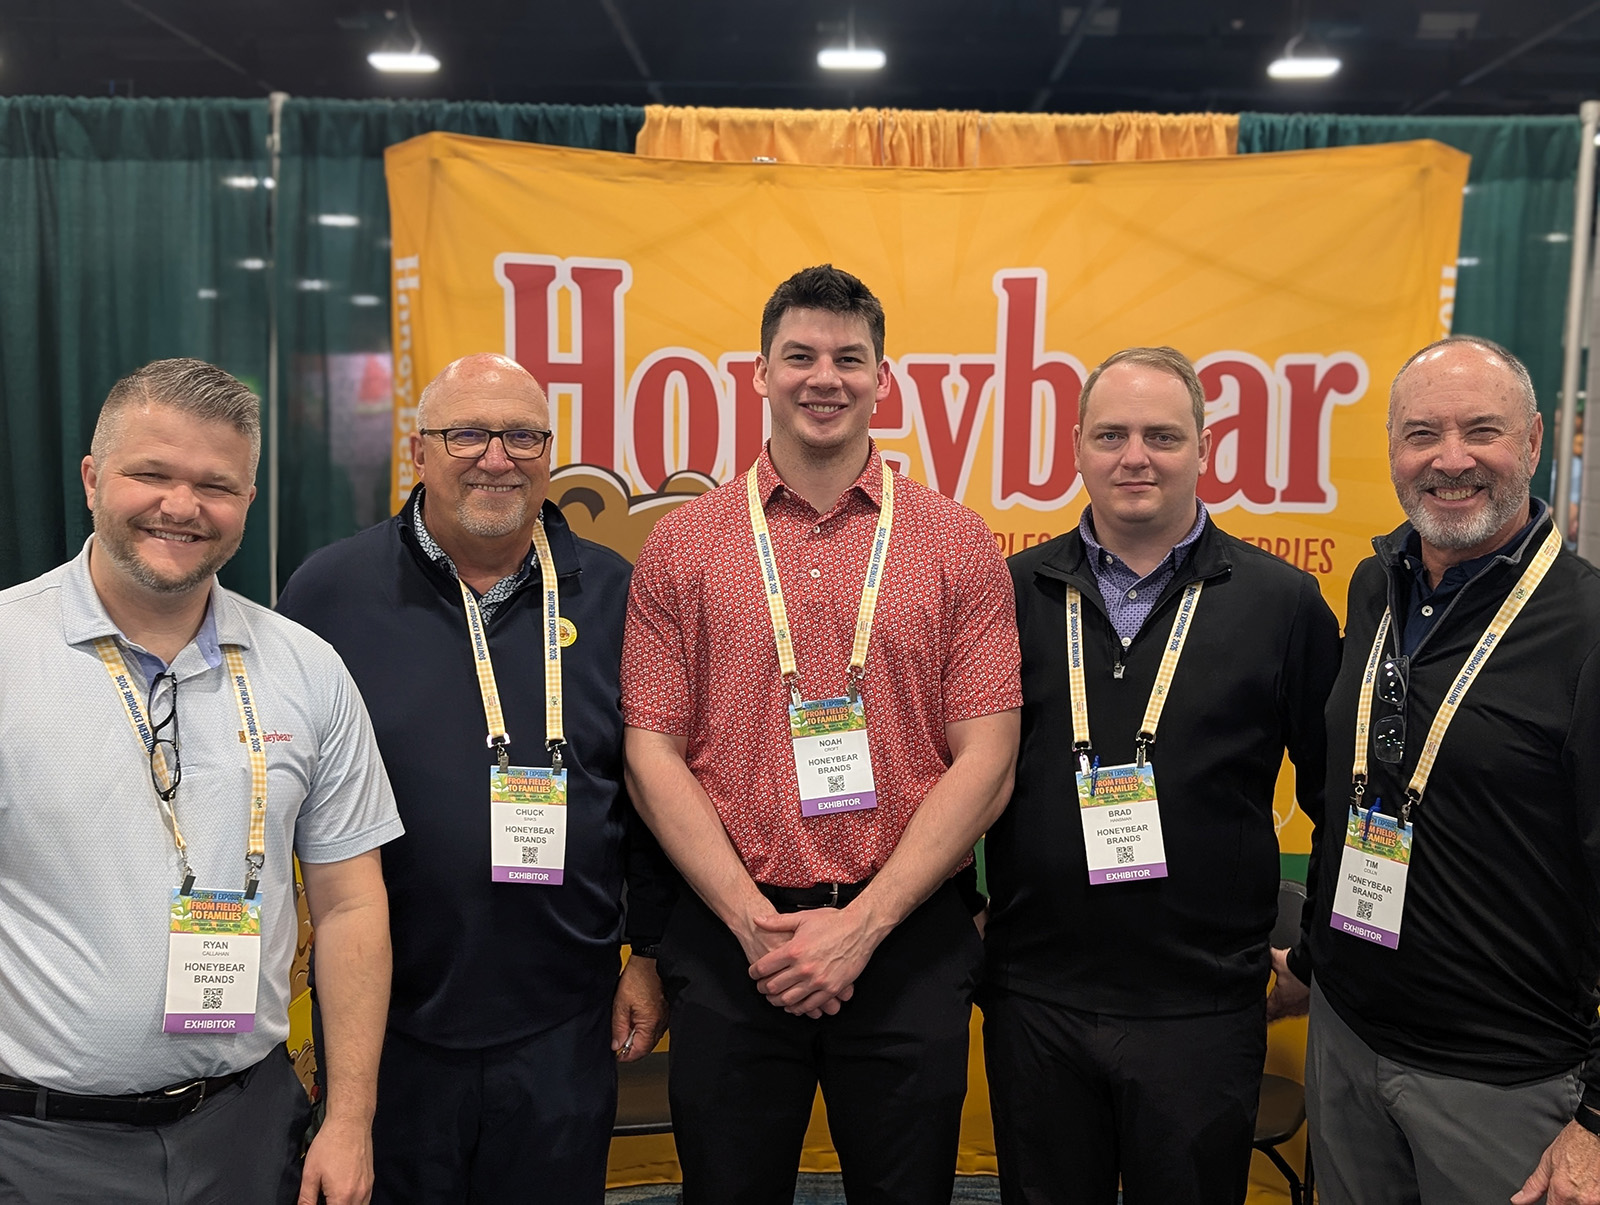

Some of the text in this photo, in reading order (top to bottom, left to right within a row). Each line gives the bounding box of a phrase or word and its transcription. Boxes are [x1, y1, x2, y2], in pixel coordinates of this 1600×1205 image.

[758, 533, 770, 558] SOUTHERN
[764, 558, 775, 581] EXPOSURE
[867, 563, 879, 588] SOUTHERN
[873, 540, 884, 563] EXPOSURE
[468, 604, 479, 631] EXPOSURE
[1170, 587, 1196, 651] SOUTHERN EXPOSURE 2026
[547, 590, 557, 660] SOUTHERN EXPOSURE 2026
[475, 632, 486, 661] SOUTHERN
[1072, 641, 1080, 668] SOUTHERN
[1370, 641, 1381, 669] EXPOSURE
[1447, 632, 1497, 705] SOUTHERN EXPOSURE 2026
[115, 675, 130, 690] 2026
[123, 690, 144, 723] EXPOSURE
[235, 675, 261, 752] SOUTHERN EXPOSURE 2026
[807, 707, 848, 718] FROM FIELDS
[817, 714, 849, 723] FAMILIES
[819, 738, 842, 747] NOAH
[808, 753, 859, 766] HONEYBEAR
[818, 764, 852, 774] BRANDS
[1115, 776, 1138, 784] FIELDS
[518, 785, 550, 793] FAMILIES
[1106, 784, 1138, 793] FAMILIES
[818, 798, 861, 810] EXHIBITOR
[1108, 809, 1132, 817] BRAD
[505, 826, 555, 834] HONEYBEAR
[1097, 824, 1148, 836] HONEYBEAR
[1376, 826, 1397, 838] FIELDS
[513, 836, 547, 844] BRANDS
[1106, 835, 1141, 844] BRANDS
[1365, 859, 1378, 869] TIM
[508, 872, 549, 880] EXHIBITOR
[1106, 869, 1150, 880] EXHIBITOR
[1348, 873, 1392, 894] HONEYBEAR
[1352, 886, 1383, 902] BRANDS
[191, 901, 242, 911] FROM FIELDS
[191, 911, 242, 920] TO FAMILIES
[1343, 922, 1382, 941] EXHIBITOR
[203, 941, 228, 949] RYAN
[184, 963, 245, 972] HONEYBEAR
[194, 975, 234, 983] BRANDS
[184, 1020, 236, 1029] EXHIBITOR
